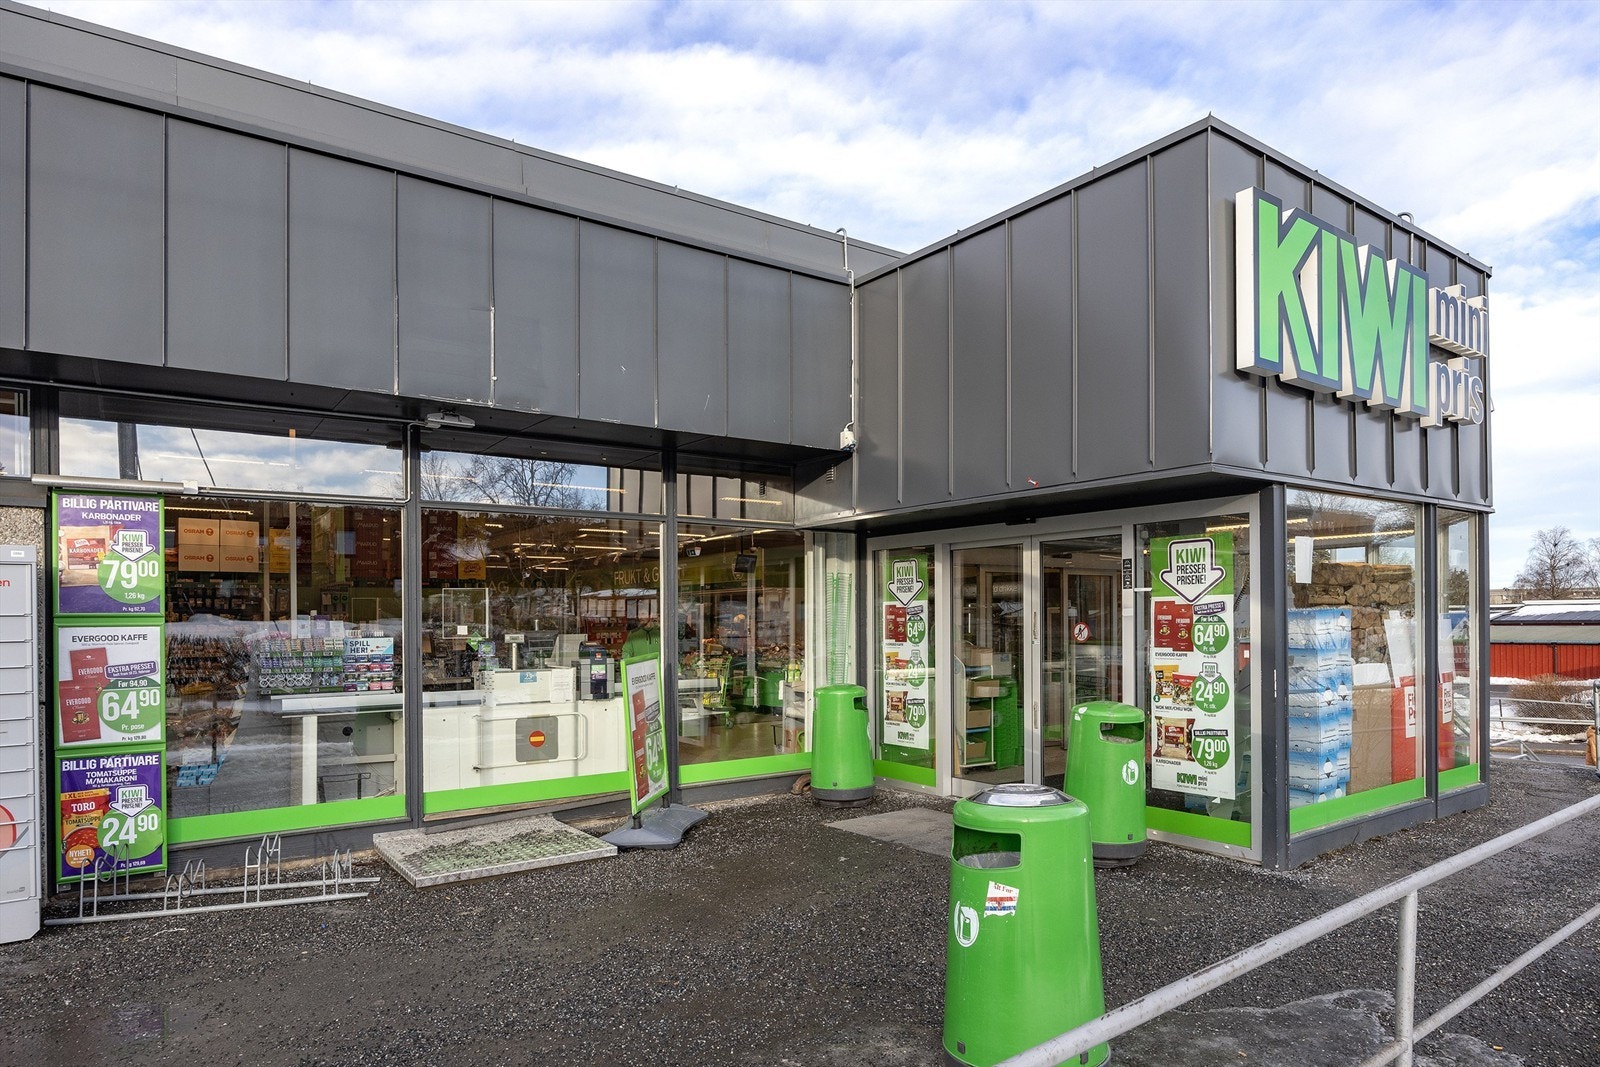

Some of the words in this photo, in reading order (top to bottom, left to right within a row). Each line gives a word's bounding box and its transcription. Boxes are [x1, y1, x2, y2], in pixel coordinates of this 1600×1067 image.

[1253, 187, 1429, 419] KIWI
[1434, 283, 1487, 357] mini
[1434, 356, 1483, 427] pris
[62, 498, 97, 509] BILLIG
[100, 499, 159, 512] PARTIVARE
[82, 512, 141, 521] KARBONADER
[121, 533, 144, 543] KIWI
[1176, 547, 1206, 564] KIWI
[896, 566, 914, 577] KIWI
[1176, 564, 1206, 575] PRESSER
[613, 569, 641, 585] FRUKT
[643, 567, 650, 583] &
[1176, 574, 1206, 585] PRISENE!
[137, 592, 145, 600] kg
[72, 634, 119, 642] EVERGOOD
[78, 667, 103, 676] EVERGOOD
[107, 665, 130, 674] EKSTRA
[130, 662, 154, 671] PRESSET
[65, 697, 92, 706] EVERGOOD
[121, 723, 129, 731] Pr.
[62, 760, 97, 771] BILLIG
[100, 755, 159, 768] PARTIVARE
[85, 769, 137, 778] TOMATSUPPE
[1177, 772, 1197, 785] KIWI
[85, 775, 138, 785] M/MAKARONI
[121, 789, 143, 798] KIWI
[71, 801, 96, 812] TORO
[69, 849, 92, 857] NYHET!
